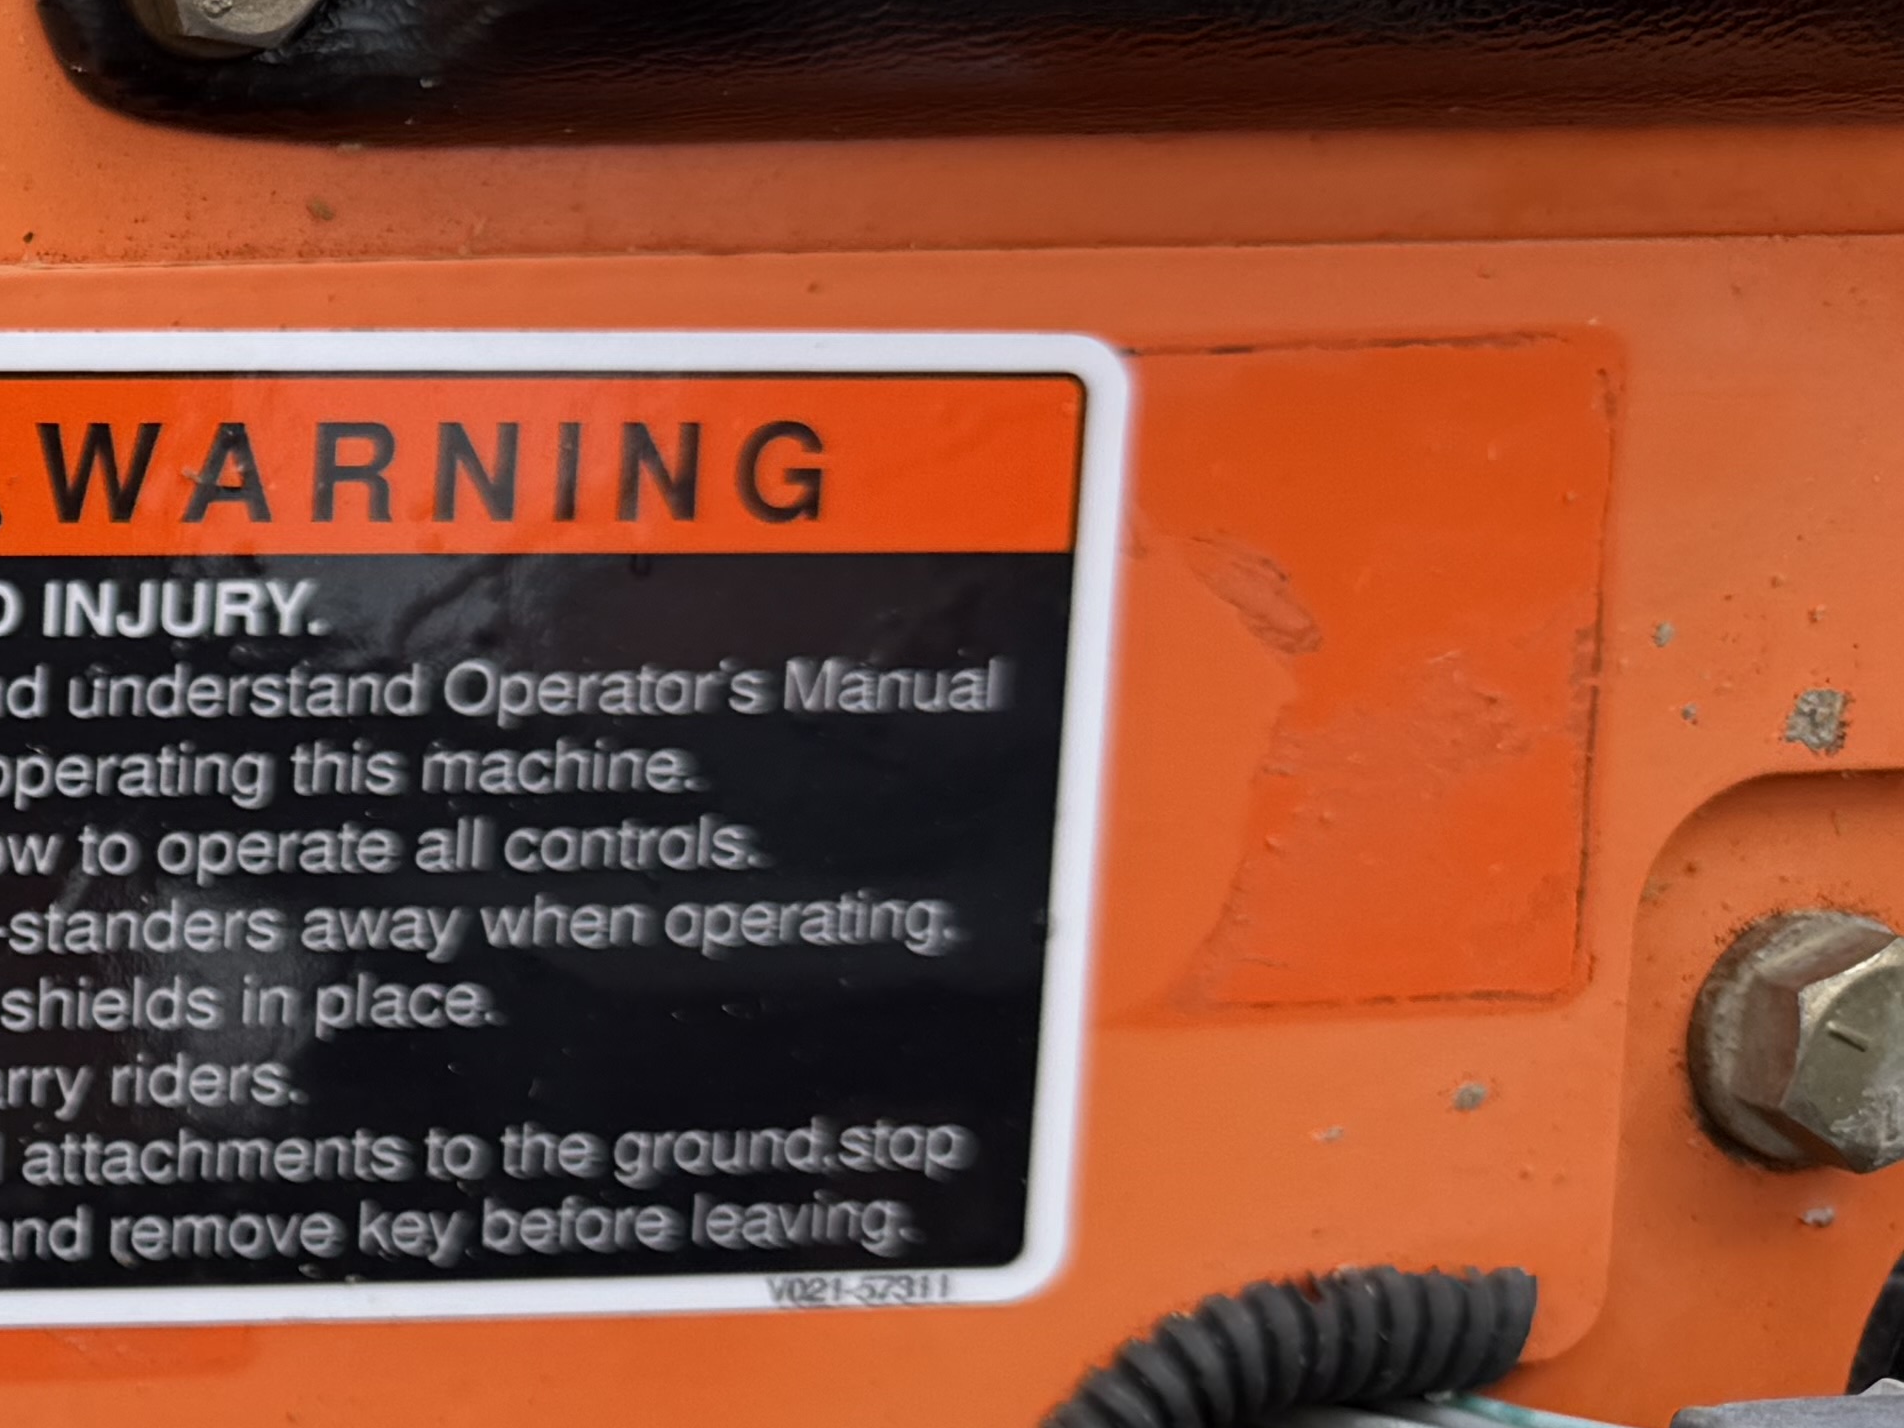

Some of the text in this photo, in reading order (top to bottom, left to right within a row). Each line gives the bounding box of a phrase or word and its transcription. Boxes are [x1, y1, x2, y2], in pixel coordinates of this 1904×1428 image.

[34, 419, 826, 525] WARNING
[66, 662, 424, 719] understand
[782, 656, 1010, 714] Manual
[290, 737, 405, 796] this
[421, 735, 707, 794] machine.
[78, 825, 142, 875] to
[156, 821, 397, 886] operate
[415, 815, 492, 873] all
[502, 813, 772, 872] controls.
[300, 906, 464, 964] away
[479, 892, 657, 949] when
[664, 887, 974, 960] operating.
[0, 975, 222, 1032] shields
[240, 974, 302, 1029] in
[314, 972, 507, 1041] place.
[110, 1052, 312, 1108] riders.
[21, 1126, 418, 1185] attachments
[423, 1126, 490, 1179] to
[500, 1120, 609, 1178] the
[109, 1211, 347, 1264] remove
[357, 1198, 468, 1268] key
[482, 1194, 687, 1256] before
[692, 1189, 927, 1259] leaving.
